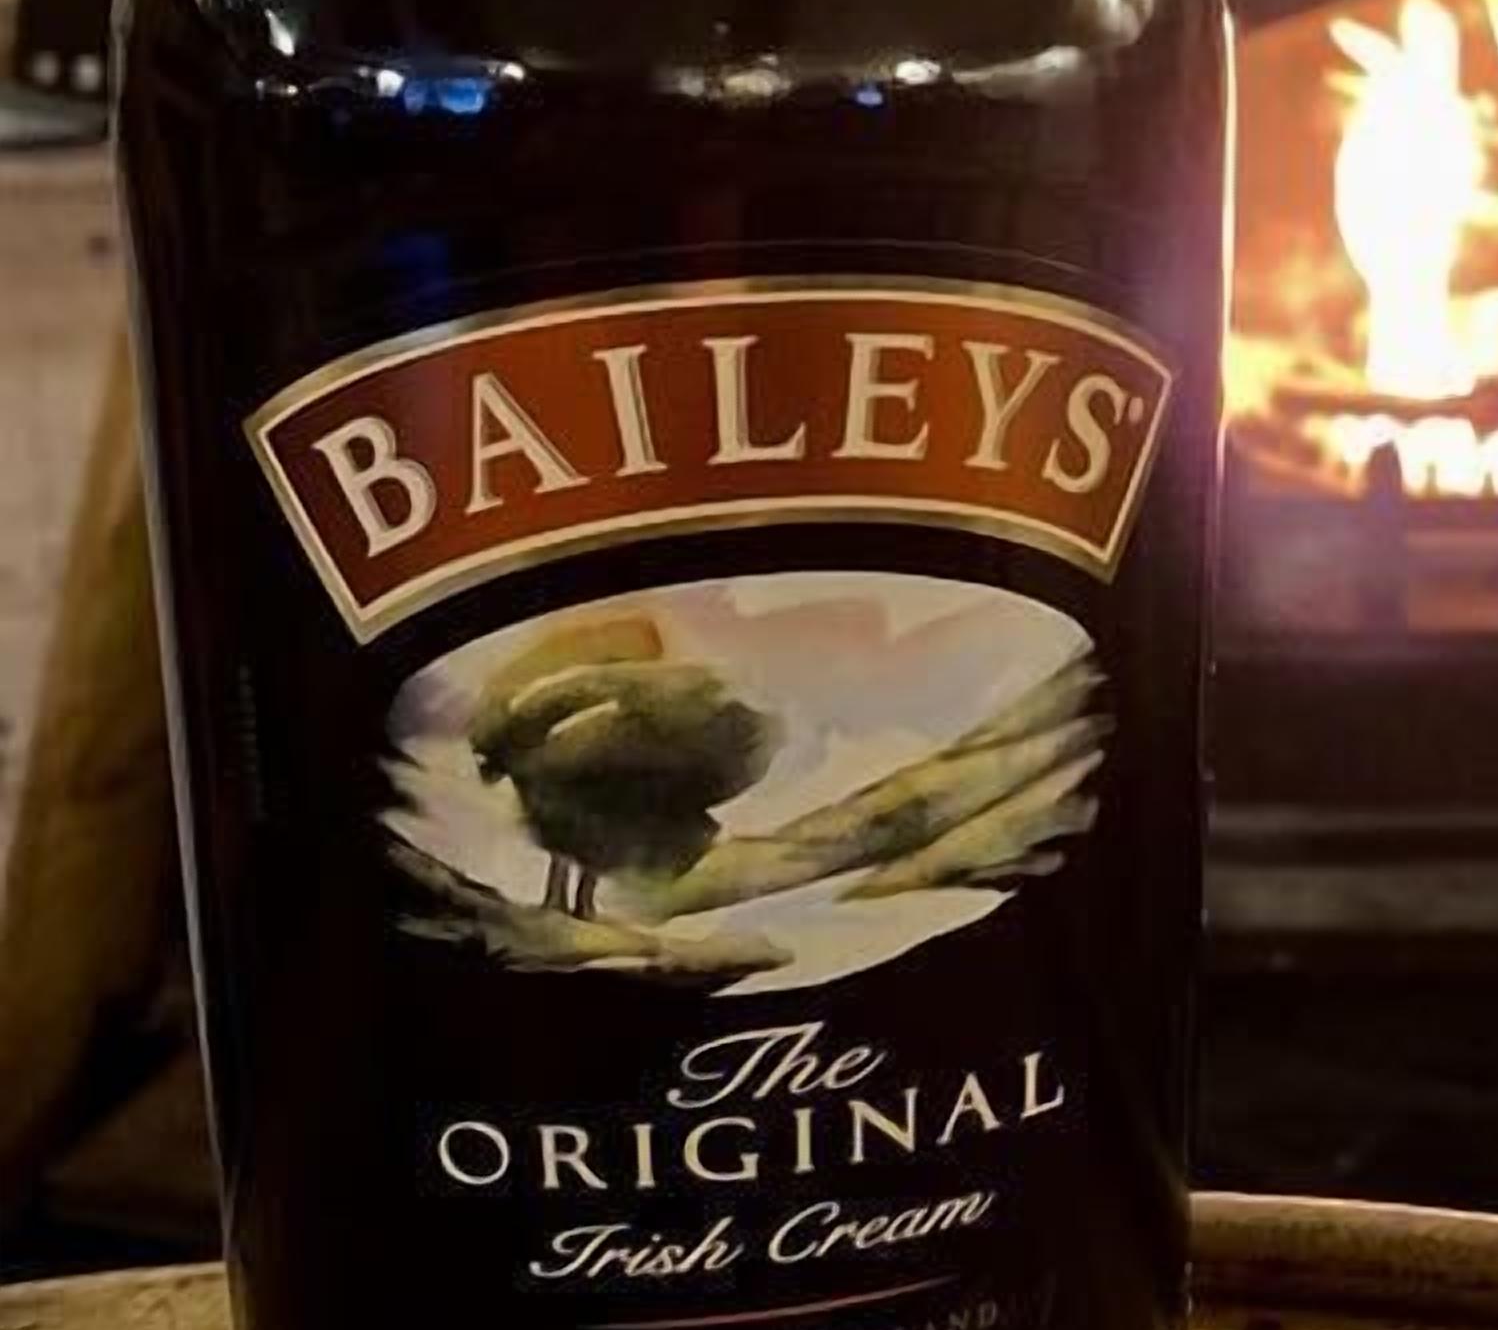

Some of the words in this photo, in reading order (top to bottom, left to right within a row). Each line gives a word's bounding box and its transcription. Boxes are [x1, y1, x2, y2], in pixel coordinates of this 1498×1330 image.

[310, 333, 1131, 558] BAILEYS
[437, 1050, 1066, 1191] ORIGINAL
[665, 1019, 886, 1110] The
[528, 1215, 746, 1278] Irish
[767, 1189, 998, 1265] Cream
